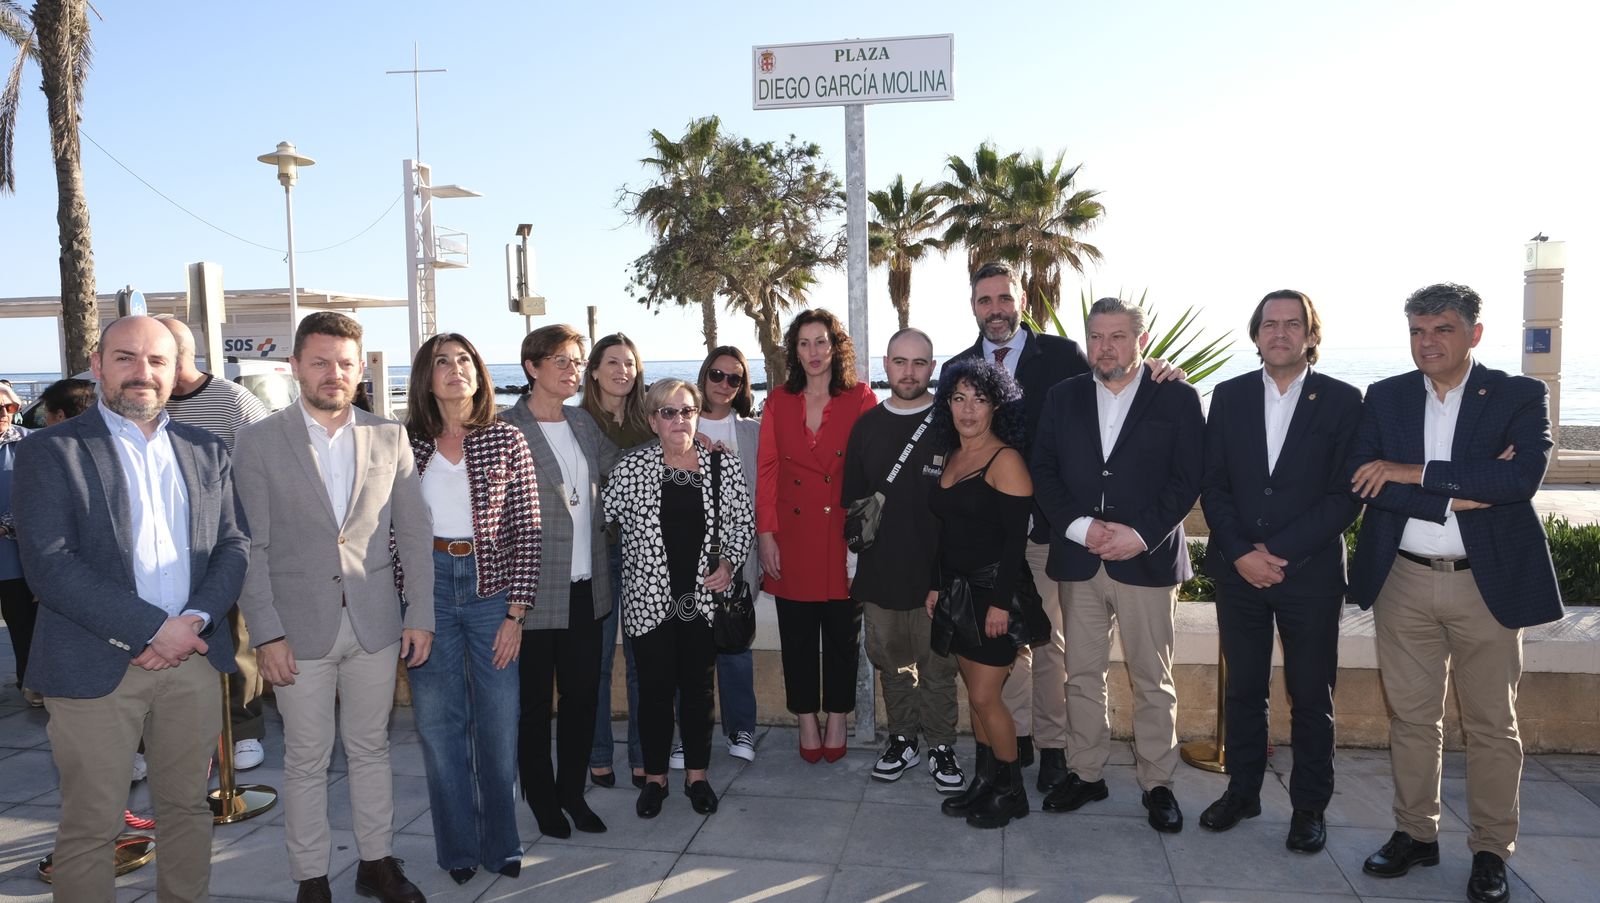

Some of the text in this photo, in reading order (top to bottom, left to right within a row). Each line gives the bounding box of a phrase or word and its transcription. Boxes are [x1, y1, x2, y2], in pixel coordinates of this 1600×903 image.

[834, 46, 890, 63] PLAZA
[758, 67, 948, 101] DIEGO GARCÍA MOLINA
[224, 338, 253, 352] SOS
